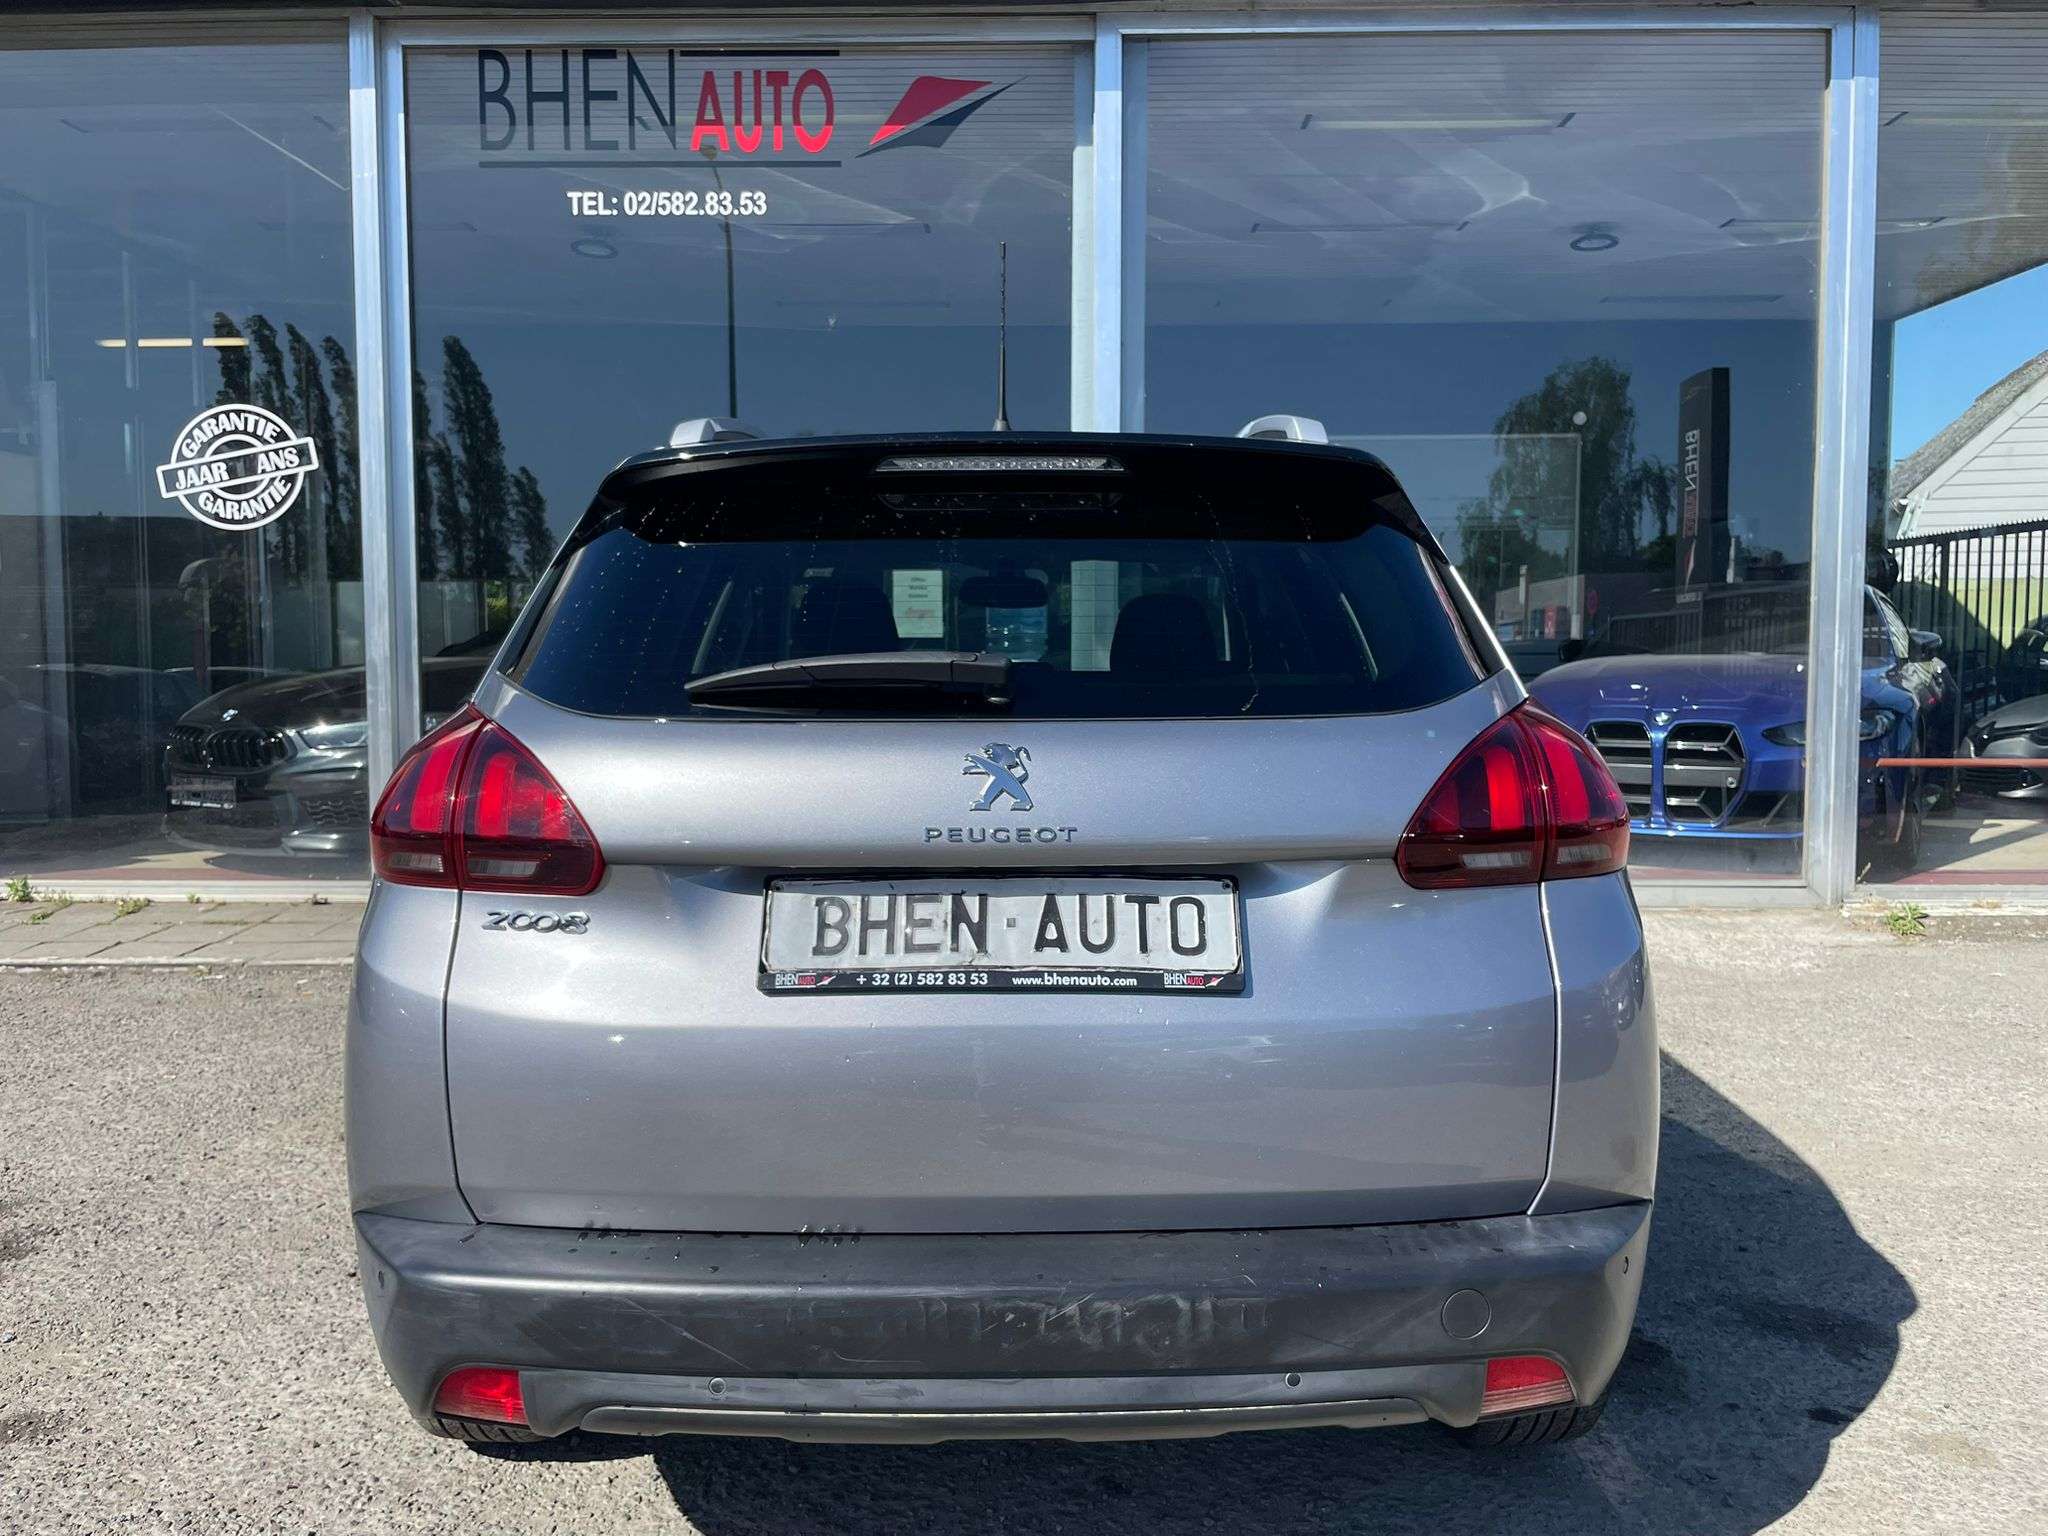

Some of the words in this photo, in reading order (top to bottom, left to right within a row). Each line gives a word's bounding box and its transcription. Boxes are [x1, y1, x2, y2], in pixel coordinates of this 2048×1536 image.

[478, 48, 679, 151] BHEN
[690, 68, 835, 153] AUTO
[567, 191, 618, 216] TEL:
[623, 190, 768, 216] 02/582.83.53
[181, 412, 281, 458] GARANTIE
[175, 461, 230, 490] JAAR
[257, 447, 300, 474] ANS
[197, 479, 293, 521] GARANTIE
[924, 826, 1078, 843] PEUGEOT
[481, 909, 591, 935] 2008
[811, 893, 989, 957] BHEN
[1033, 893, 1207, 957] AUTO
[774, 973, 799, 986] BHEN
[871, 973, 890, 986] 32
[894, 973, 913, 986] (2)
[917, 973, 944, 986] 582
[948, 973, 966, 986] 83
[969, 973, 988, 986] 53
[1011, 972, 1138, 987] www.bhenauto.com
[1163, 972, 1187, 986] BHEN
